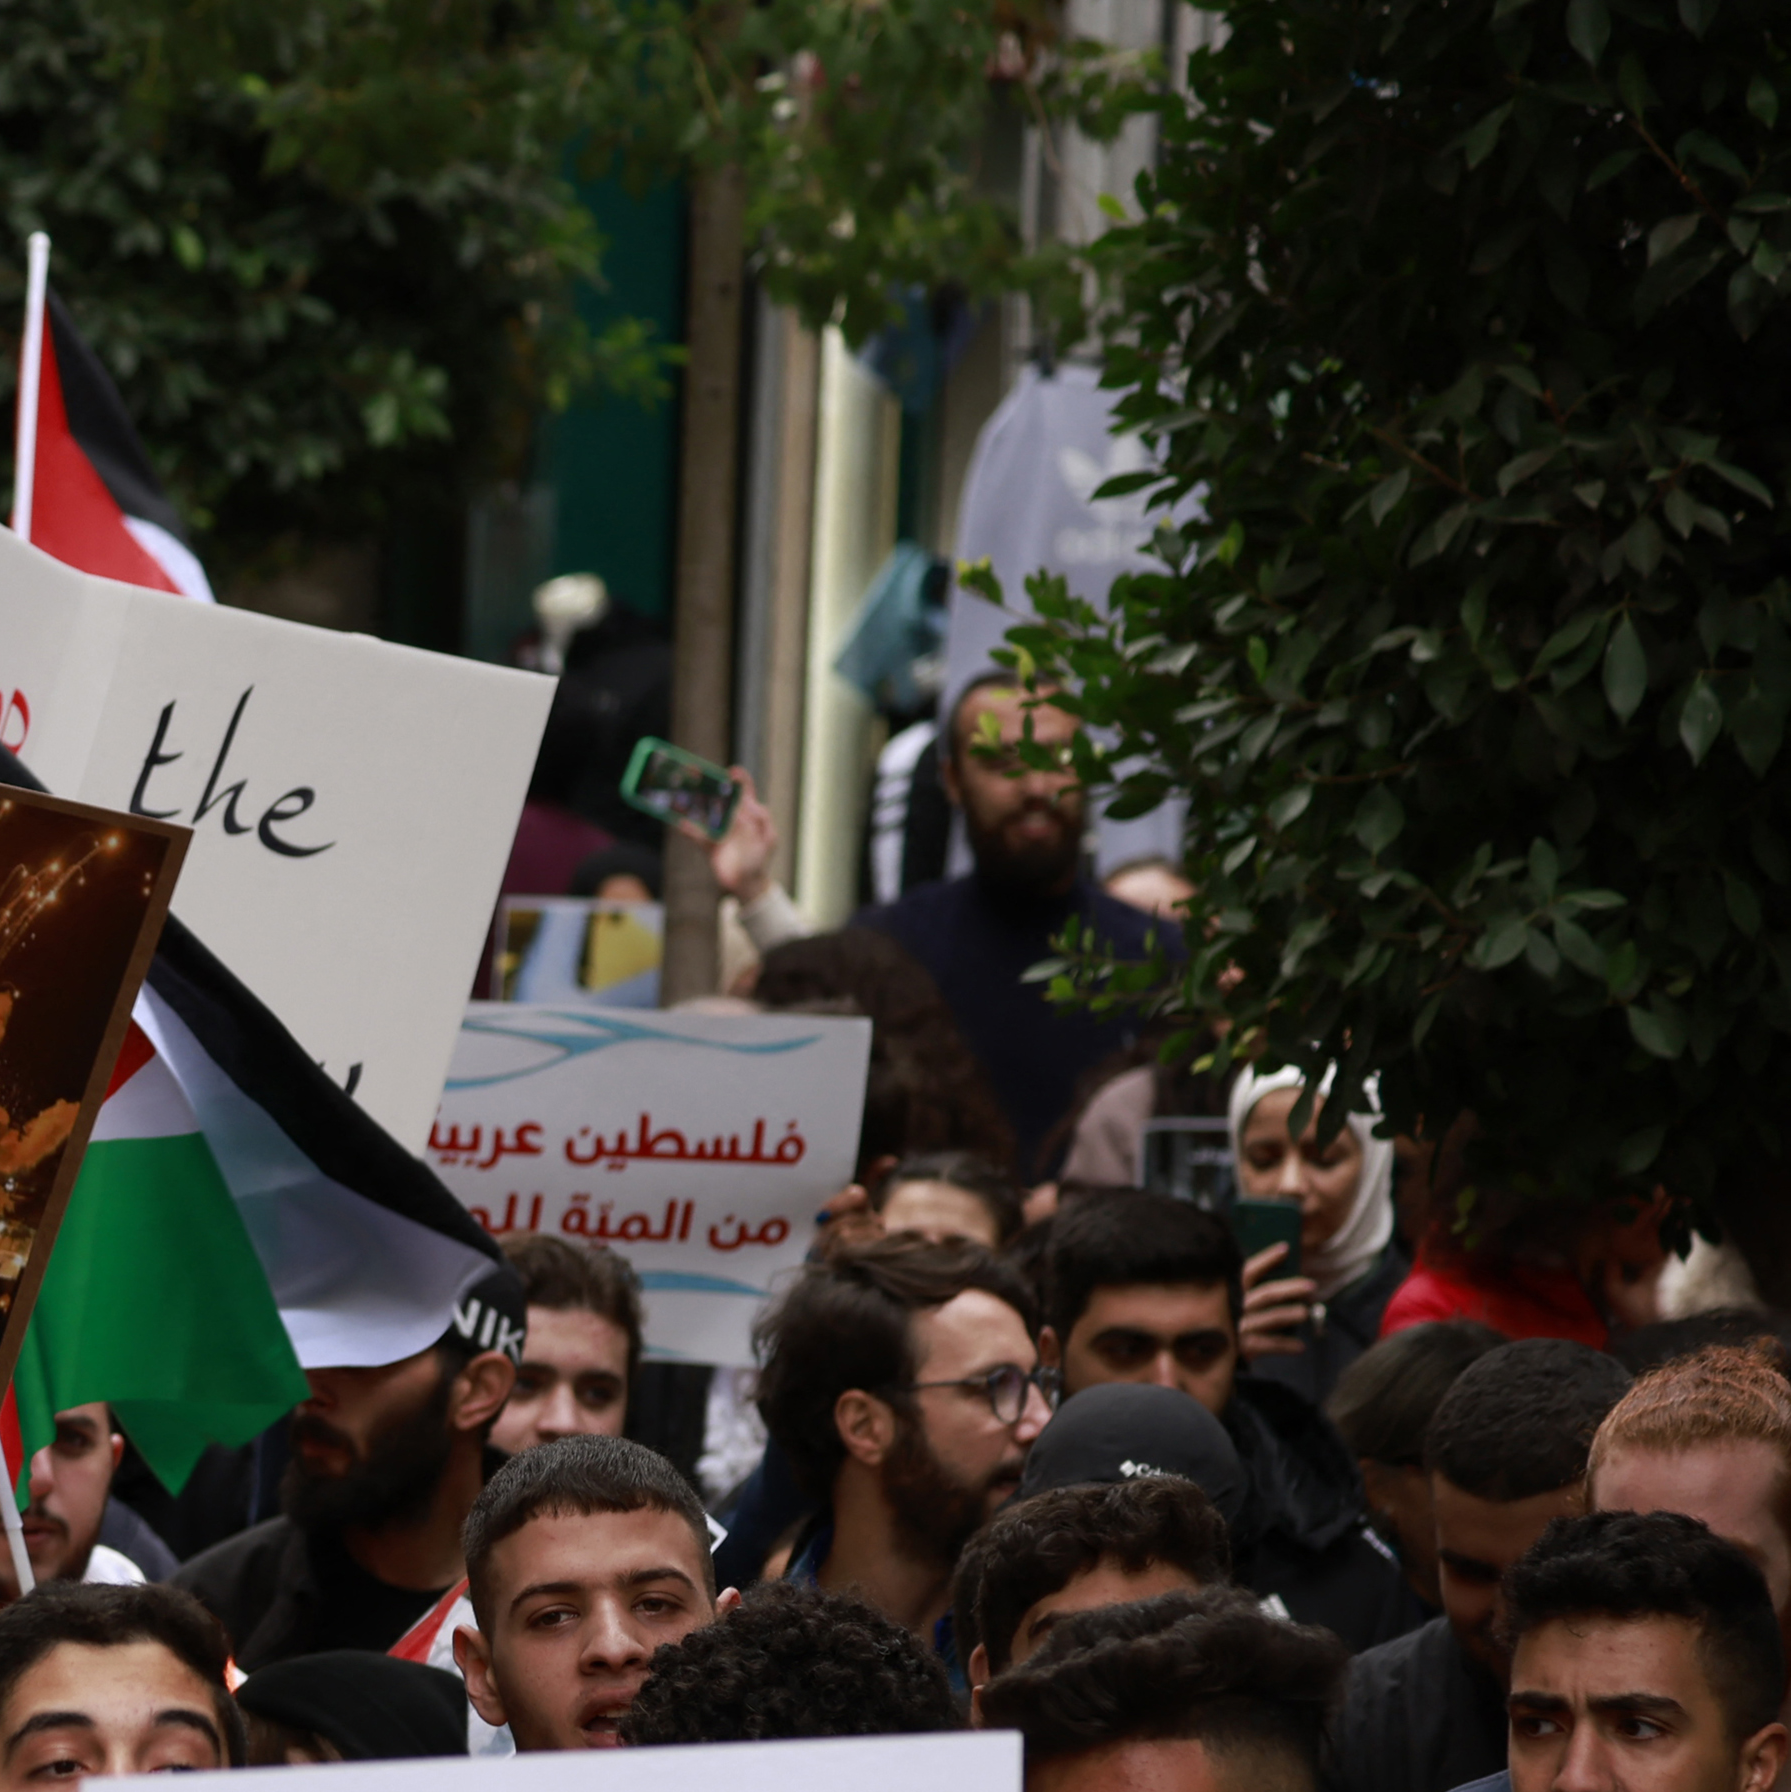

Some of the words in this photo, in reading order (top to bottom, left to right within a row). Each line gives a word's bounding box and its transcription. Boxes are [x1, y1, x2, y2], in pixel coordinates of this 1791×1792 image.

[129, 685, 336, 857] the
[564, 1112, 807, 1172] فلسطين
[468, 1193, 543, 1237] للم
[707, 1213, 791, 1251] من
[452, 1297, 526, 1367] NIK
